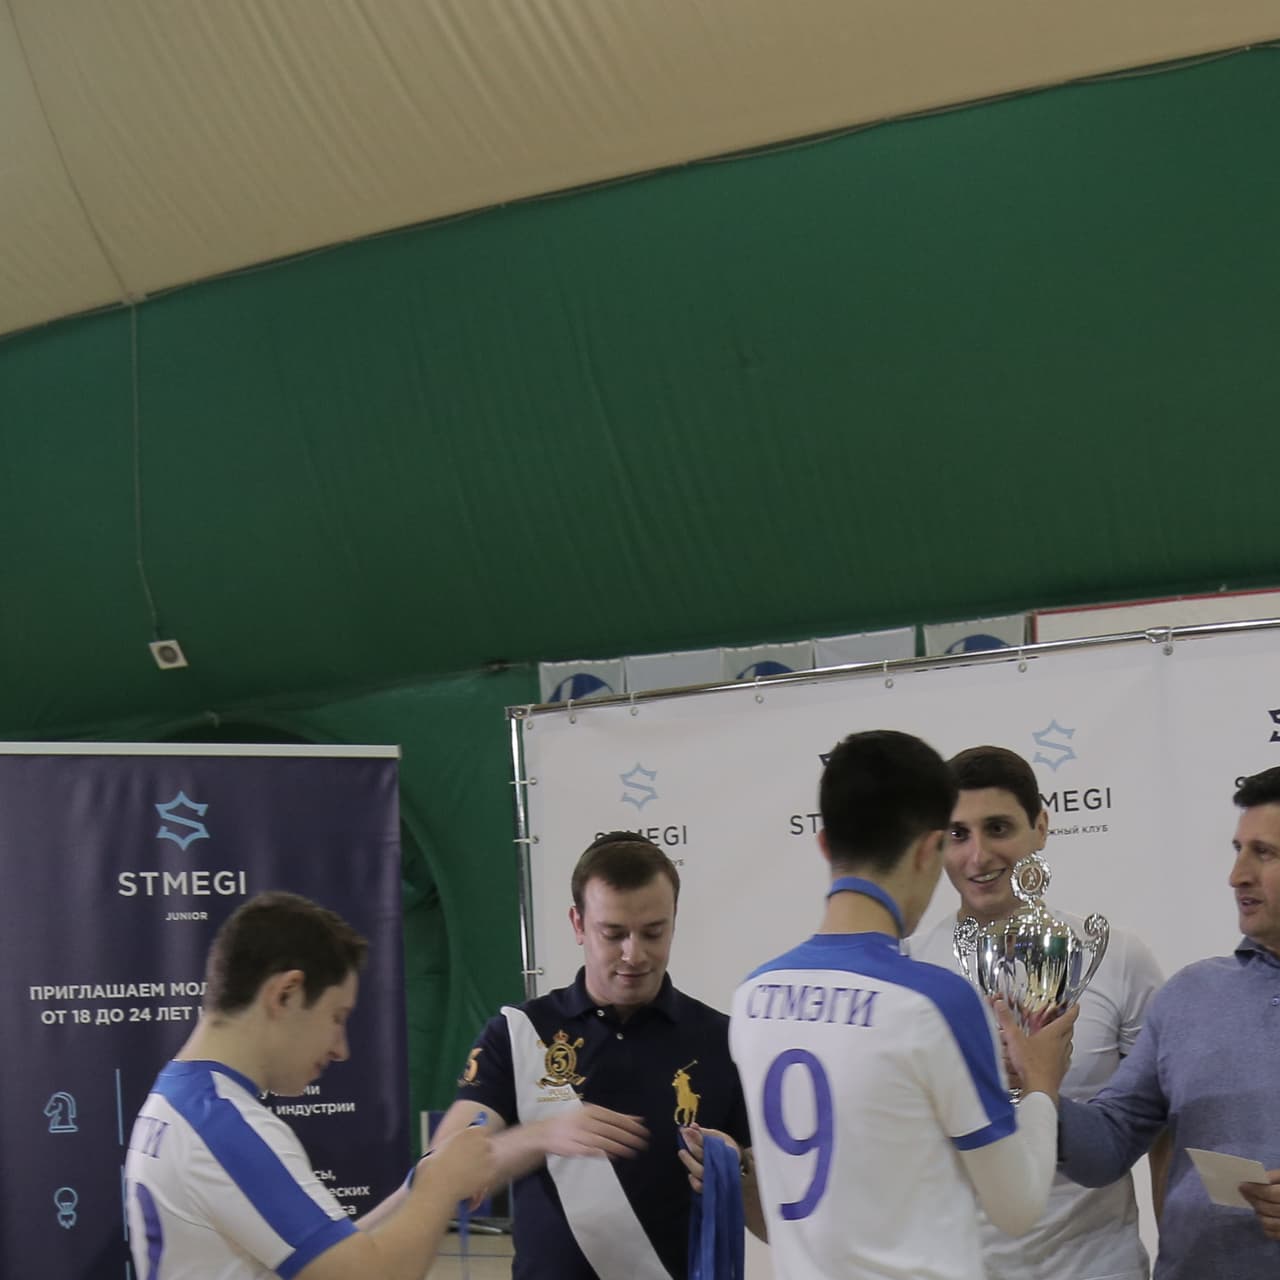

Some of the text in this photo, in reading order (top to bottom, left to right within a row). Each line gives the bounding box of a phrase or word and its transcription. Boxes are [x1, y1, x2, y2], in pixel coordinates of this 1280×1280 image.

[118, 870, 247, 896] STMEGI
[166, 911, 209, 921] JUNIOR
[30, 983, 165, 1000] ПРИГЛАШАЕМ
[41, 1010, 67, 1025] ОТ
[72, 1009, 91, 1024] 18
[96, 1008, 124, 1026] ДО
[129, 1007, 152, 1022] 24
[156, 1006, 192, 1022] ЛЕТ
[746, 984, 883, 1028] СТМЭГИ
[277, 1102, 356, 1117] индустрии
[763, 1048, 834, 1221] 9
